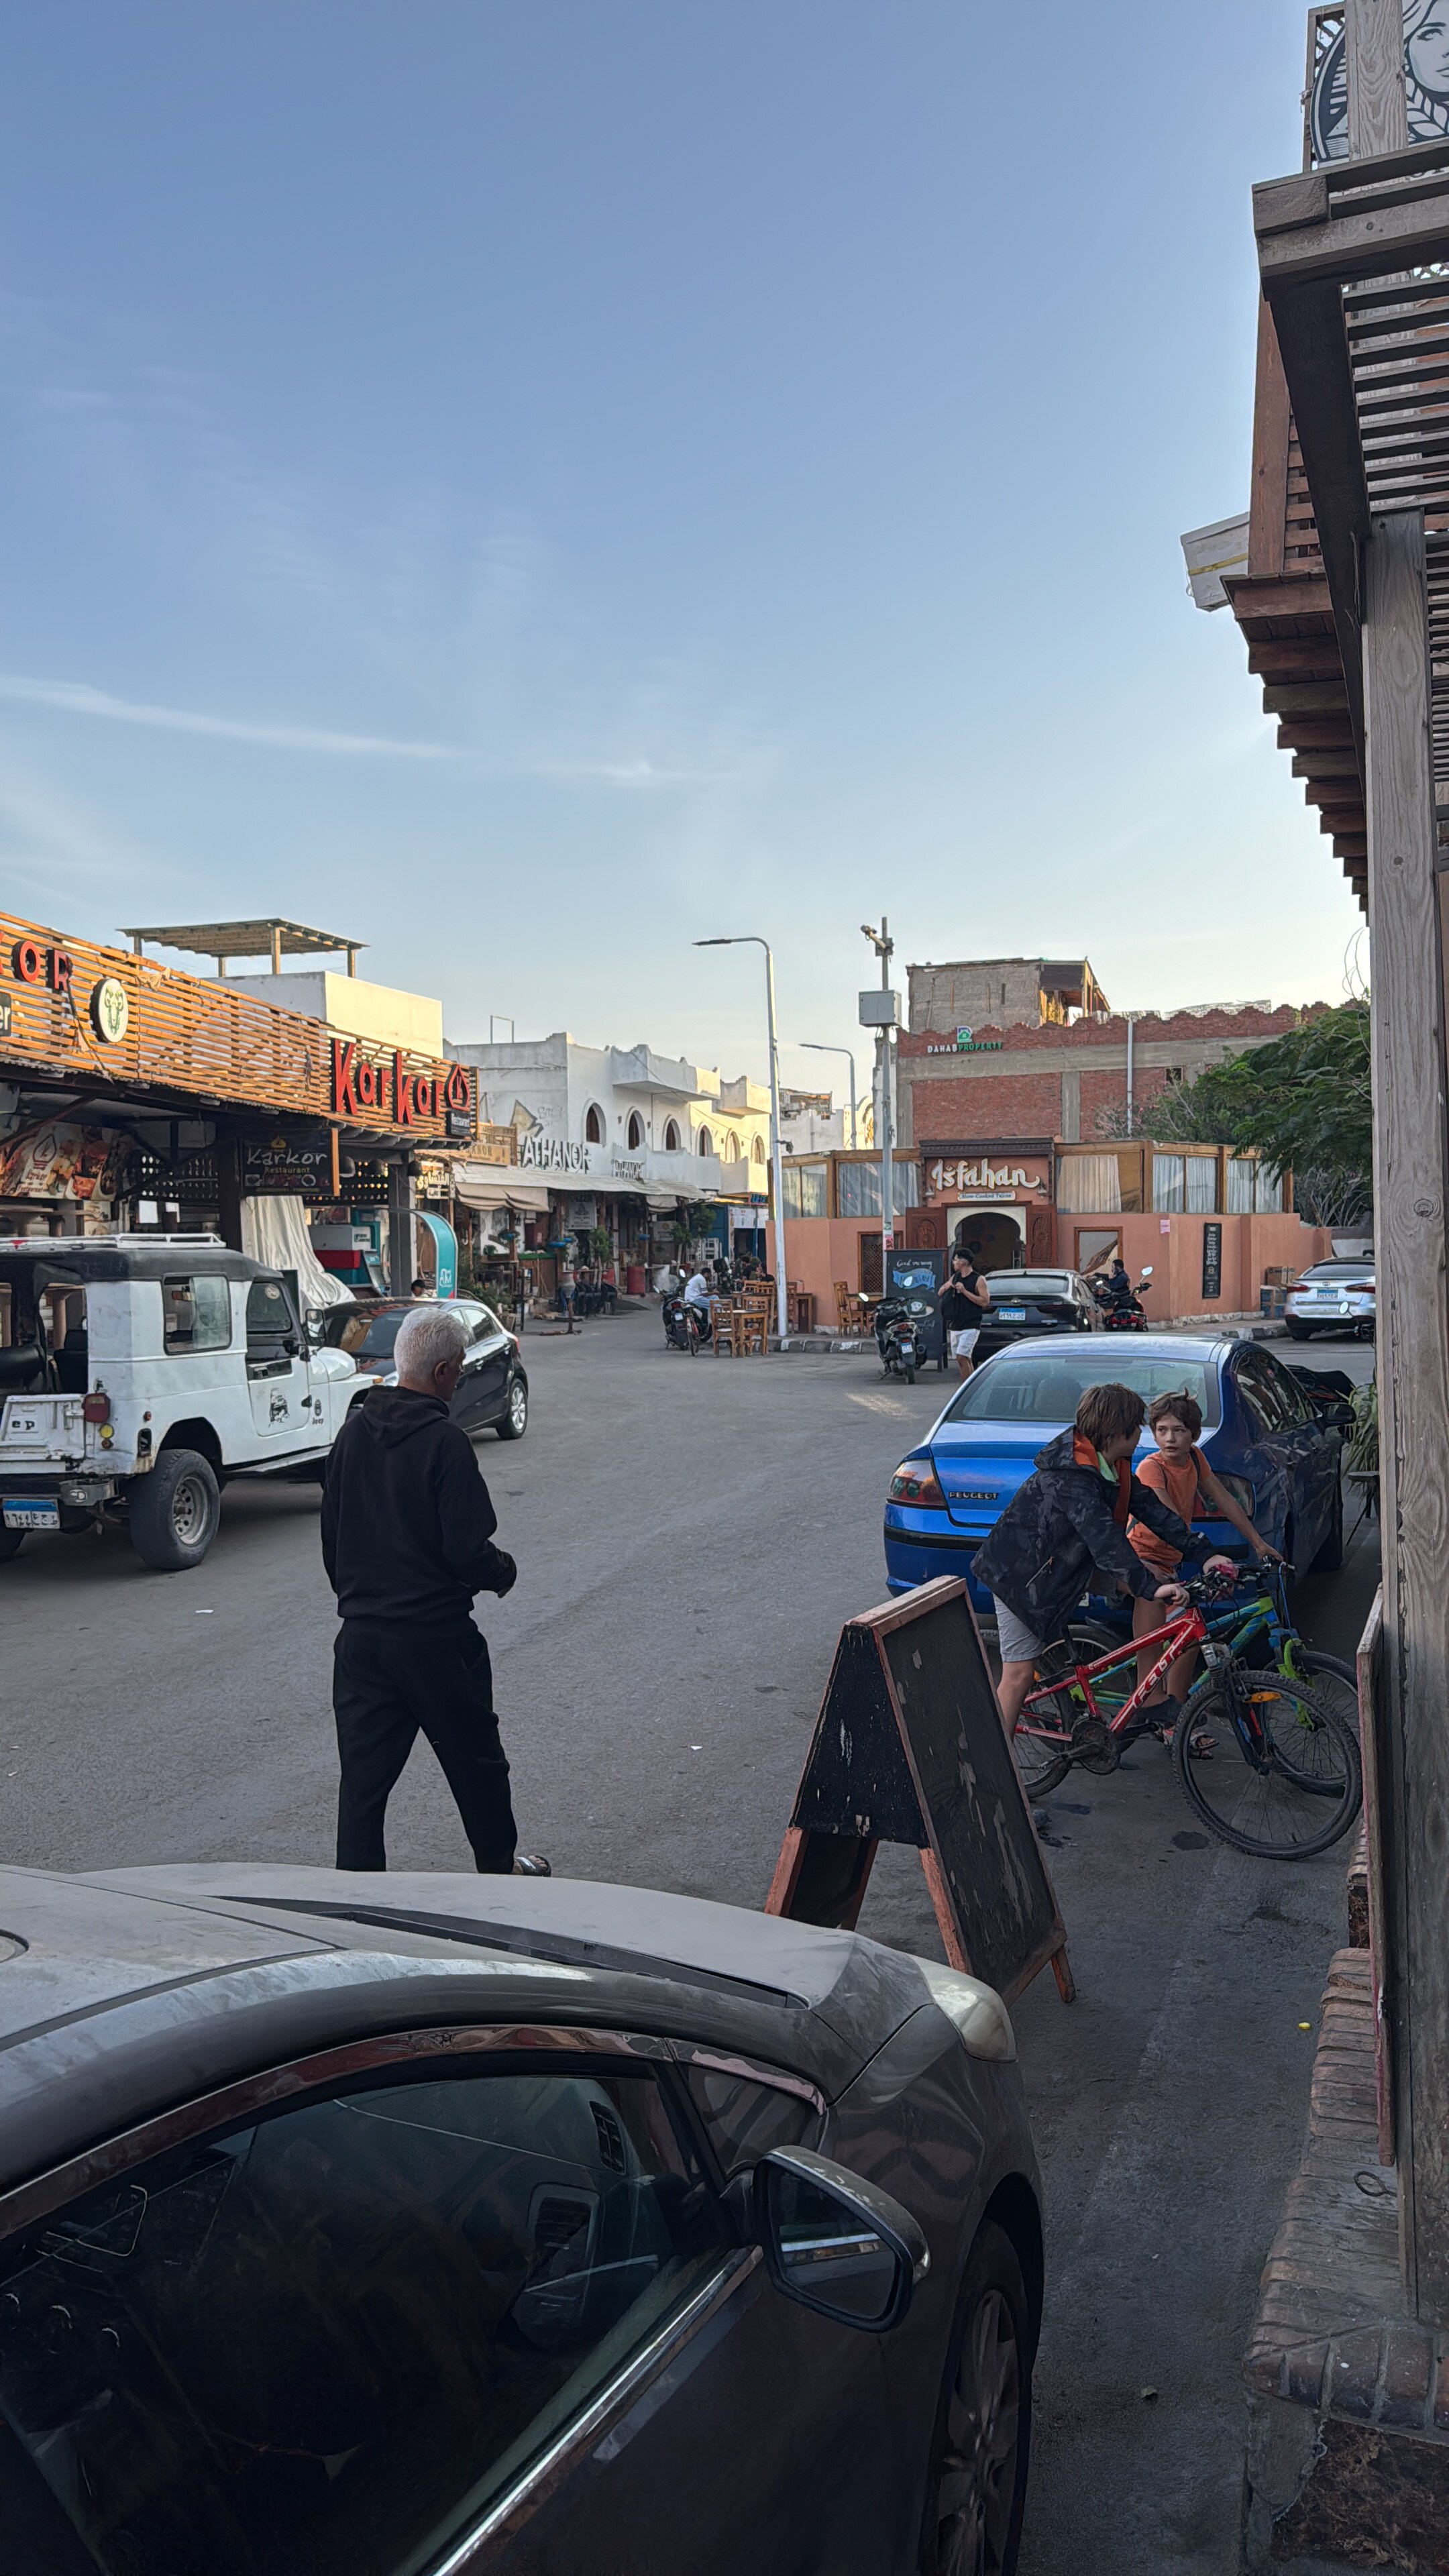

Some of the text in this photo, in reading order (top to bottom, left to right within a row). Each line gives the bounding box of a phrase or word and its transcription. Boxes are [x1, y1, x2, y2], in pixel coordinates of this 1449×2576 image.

[0, 932, 71, 991] OR
[331, 1039, 444, 1125] Karkor
[247, 1148, 327, 1165] Karkor
[523, 1135, 592, 1173] ATHANOR
[932, 1159, 1040, 1191] Isfahan
[949, 1491, 998, 1499] PEUGEOT
